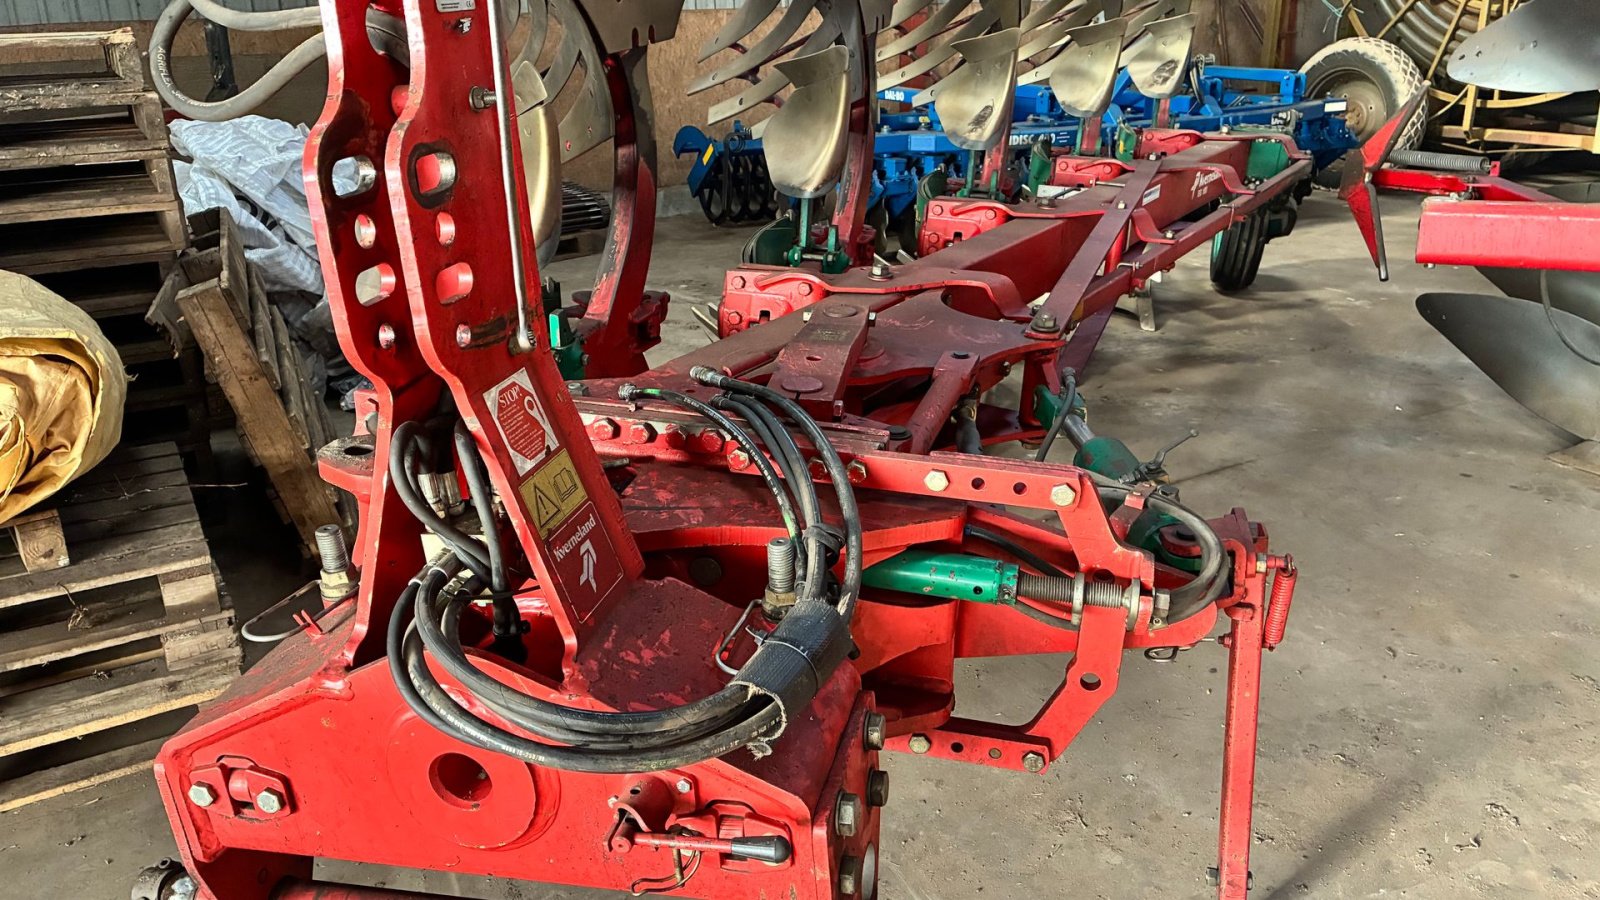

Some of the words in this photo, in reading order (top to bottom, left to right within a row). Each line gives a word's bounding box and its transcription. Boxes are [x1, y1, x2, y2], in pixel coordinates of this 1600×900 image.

[884, 90, 905, 102] DAL-BO
[498, 385, 523, 409] STOP!
[553, 513, 597, 562] Kverneland
